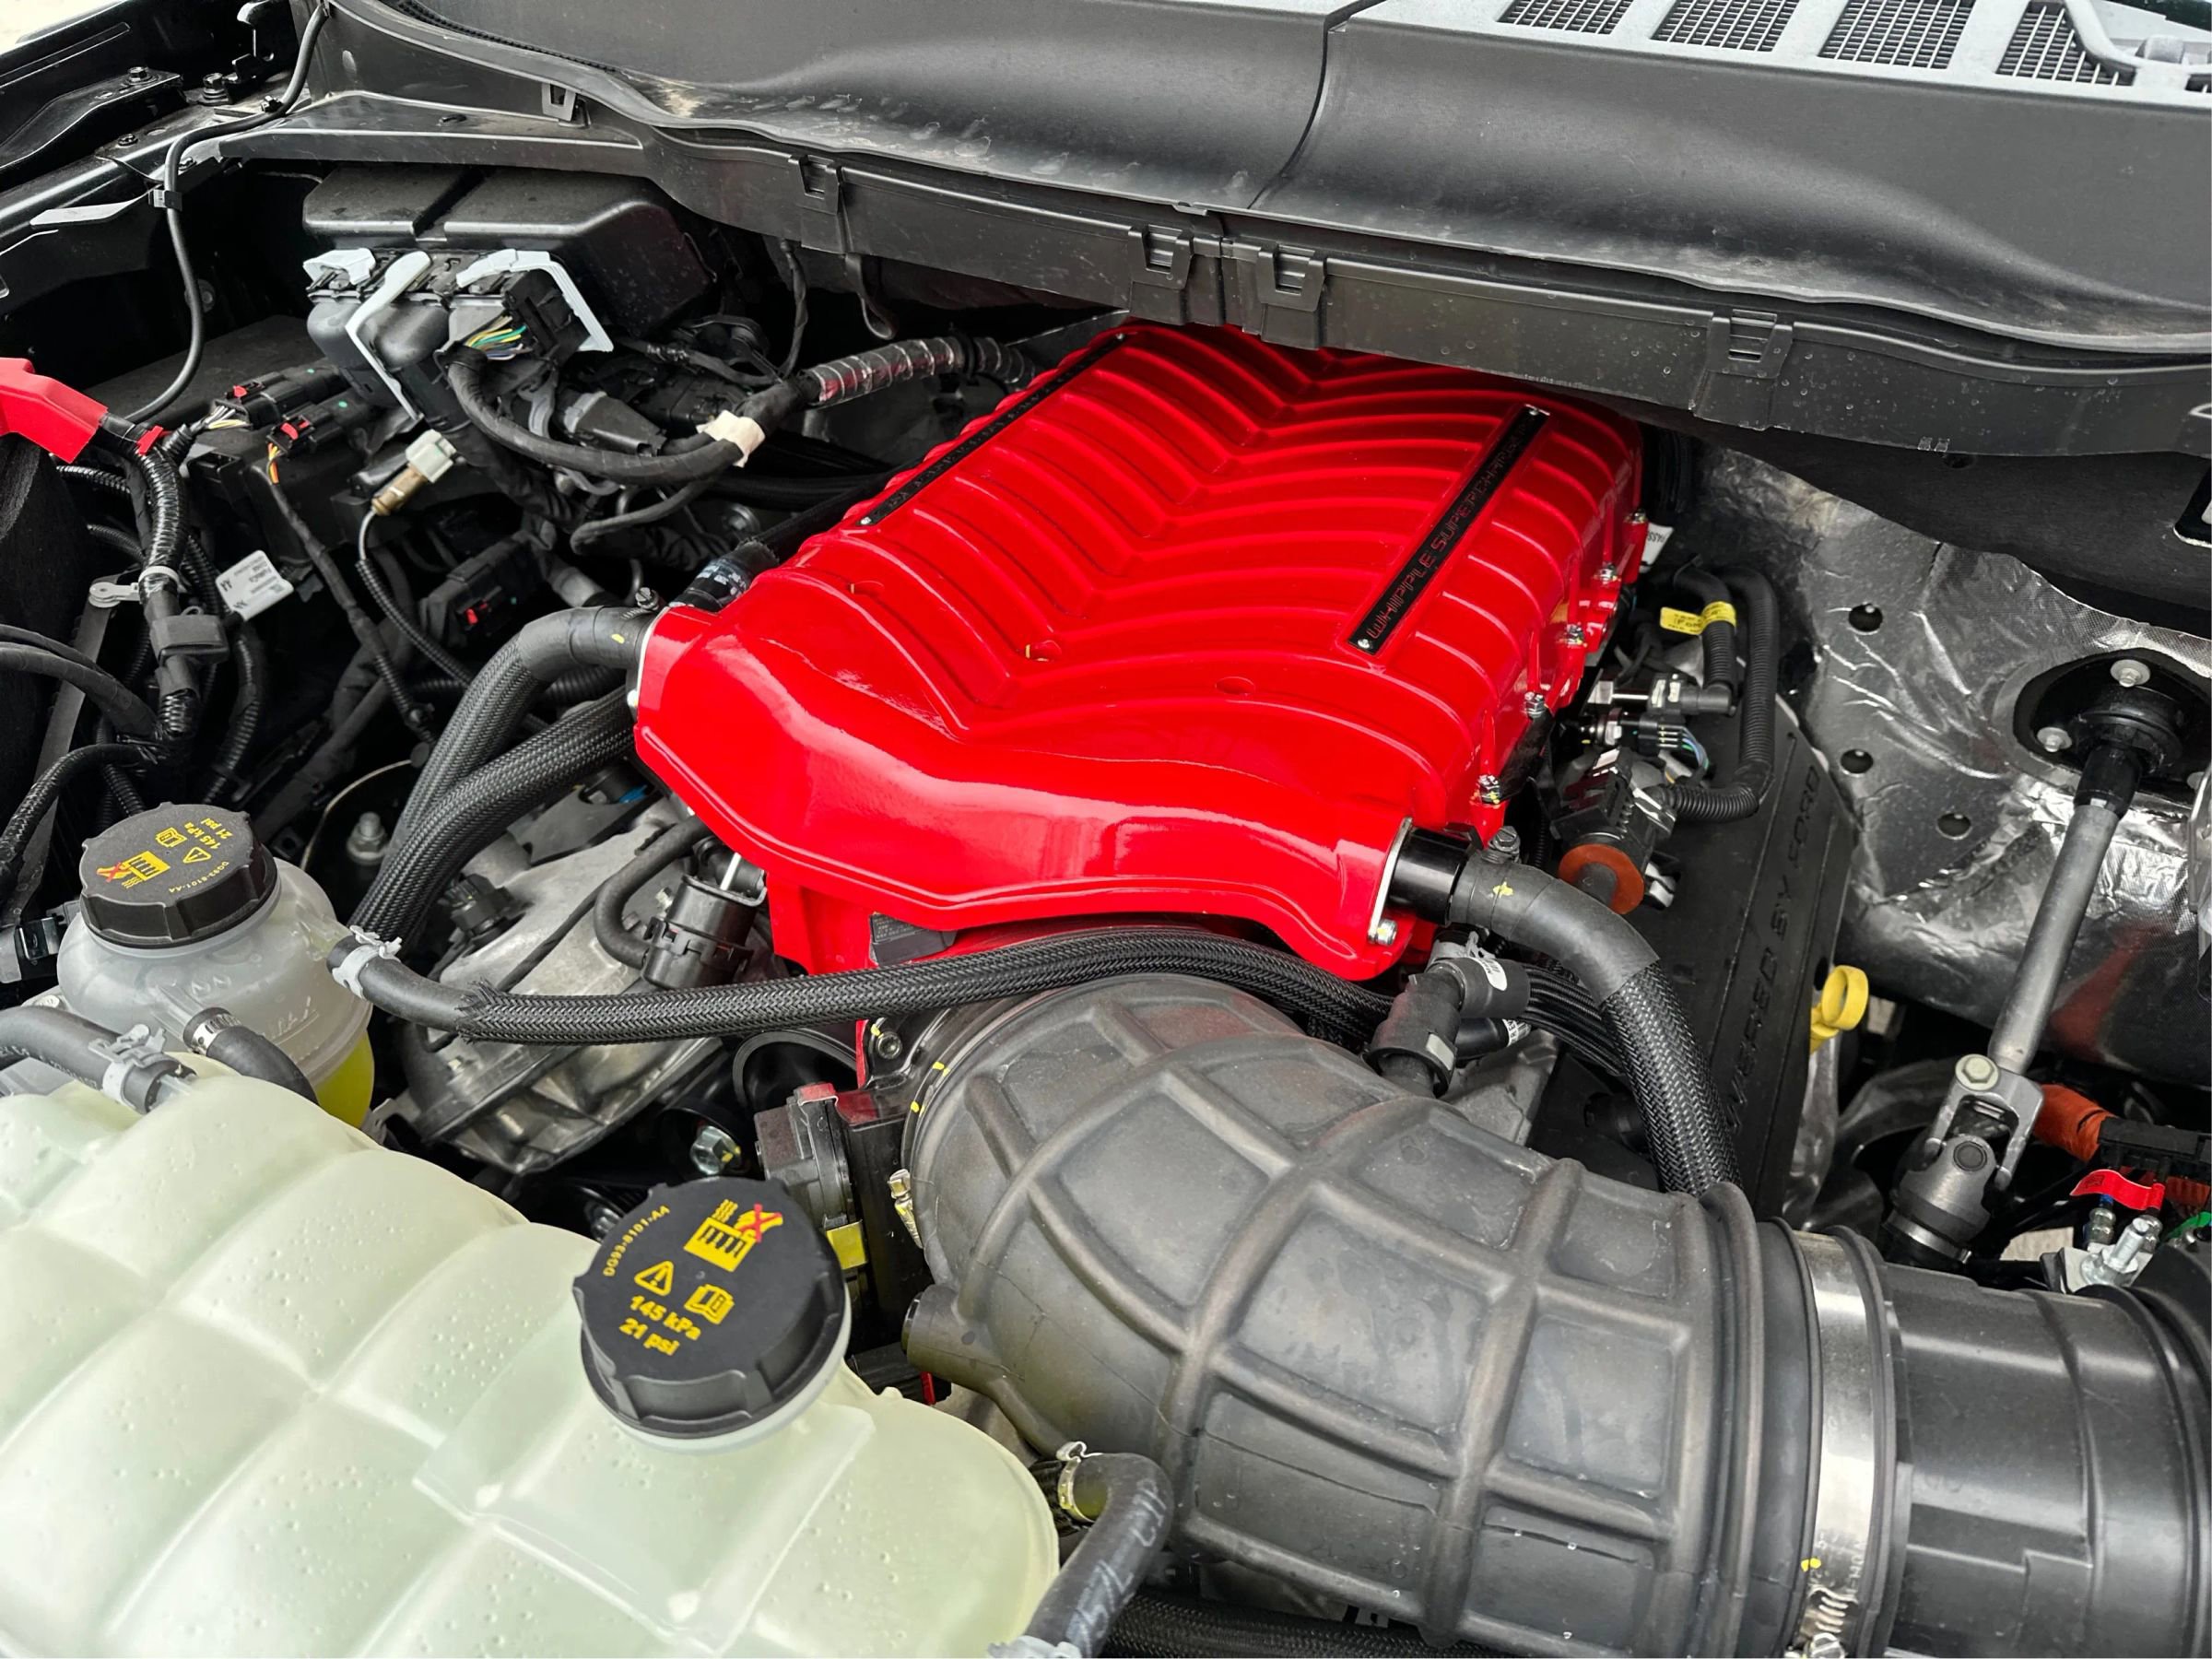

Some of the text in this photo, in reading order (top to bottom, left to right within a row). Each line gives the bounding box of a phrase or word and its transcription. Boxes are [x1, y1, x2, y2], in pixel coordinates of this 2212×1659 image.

[1366, 421, 1530, 640] WHIPPLE SUPERCHARG
[184, 822, 221, 849] 145 kPa
[201, 818, 233, 840] 21 psi
[1789, 765, 1821, 869] FORD
[618, 1317, 681, 1356] 21 psi
[629, 1295, 701, 1341] 145 kPa
